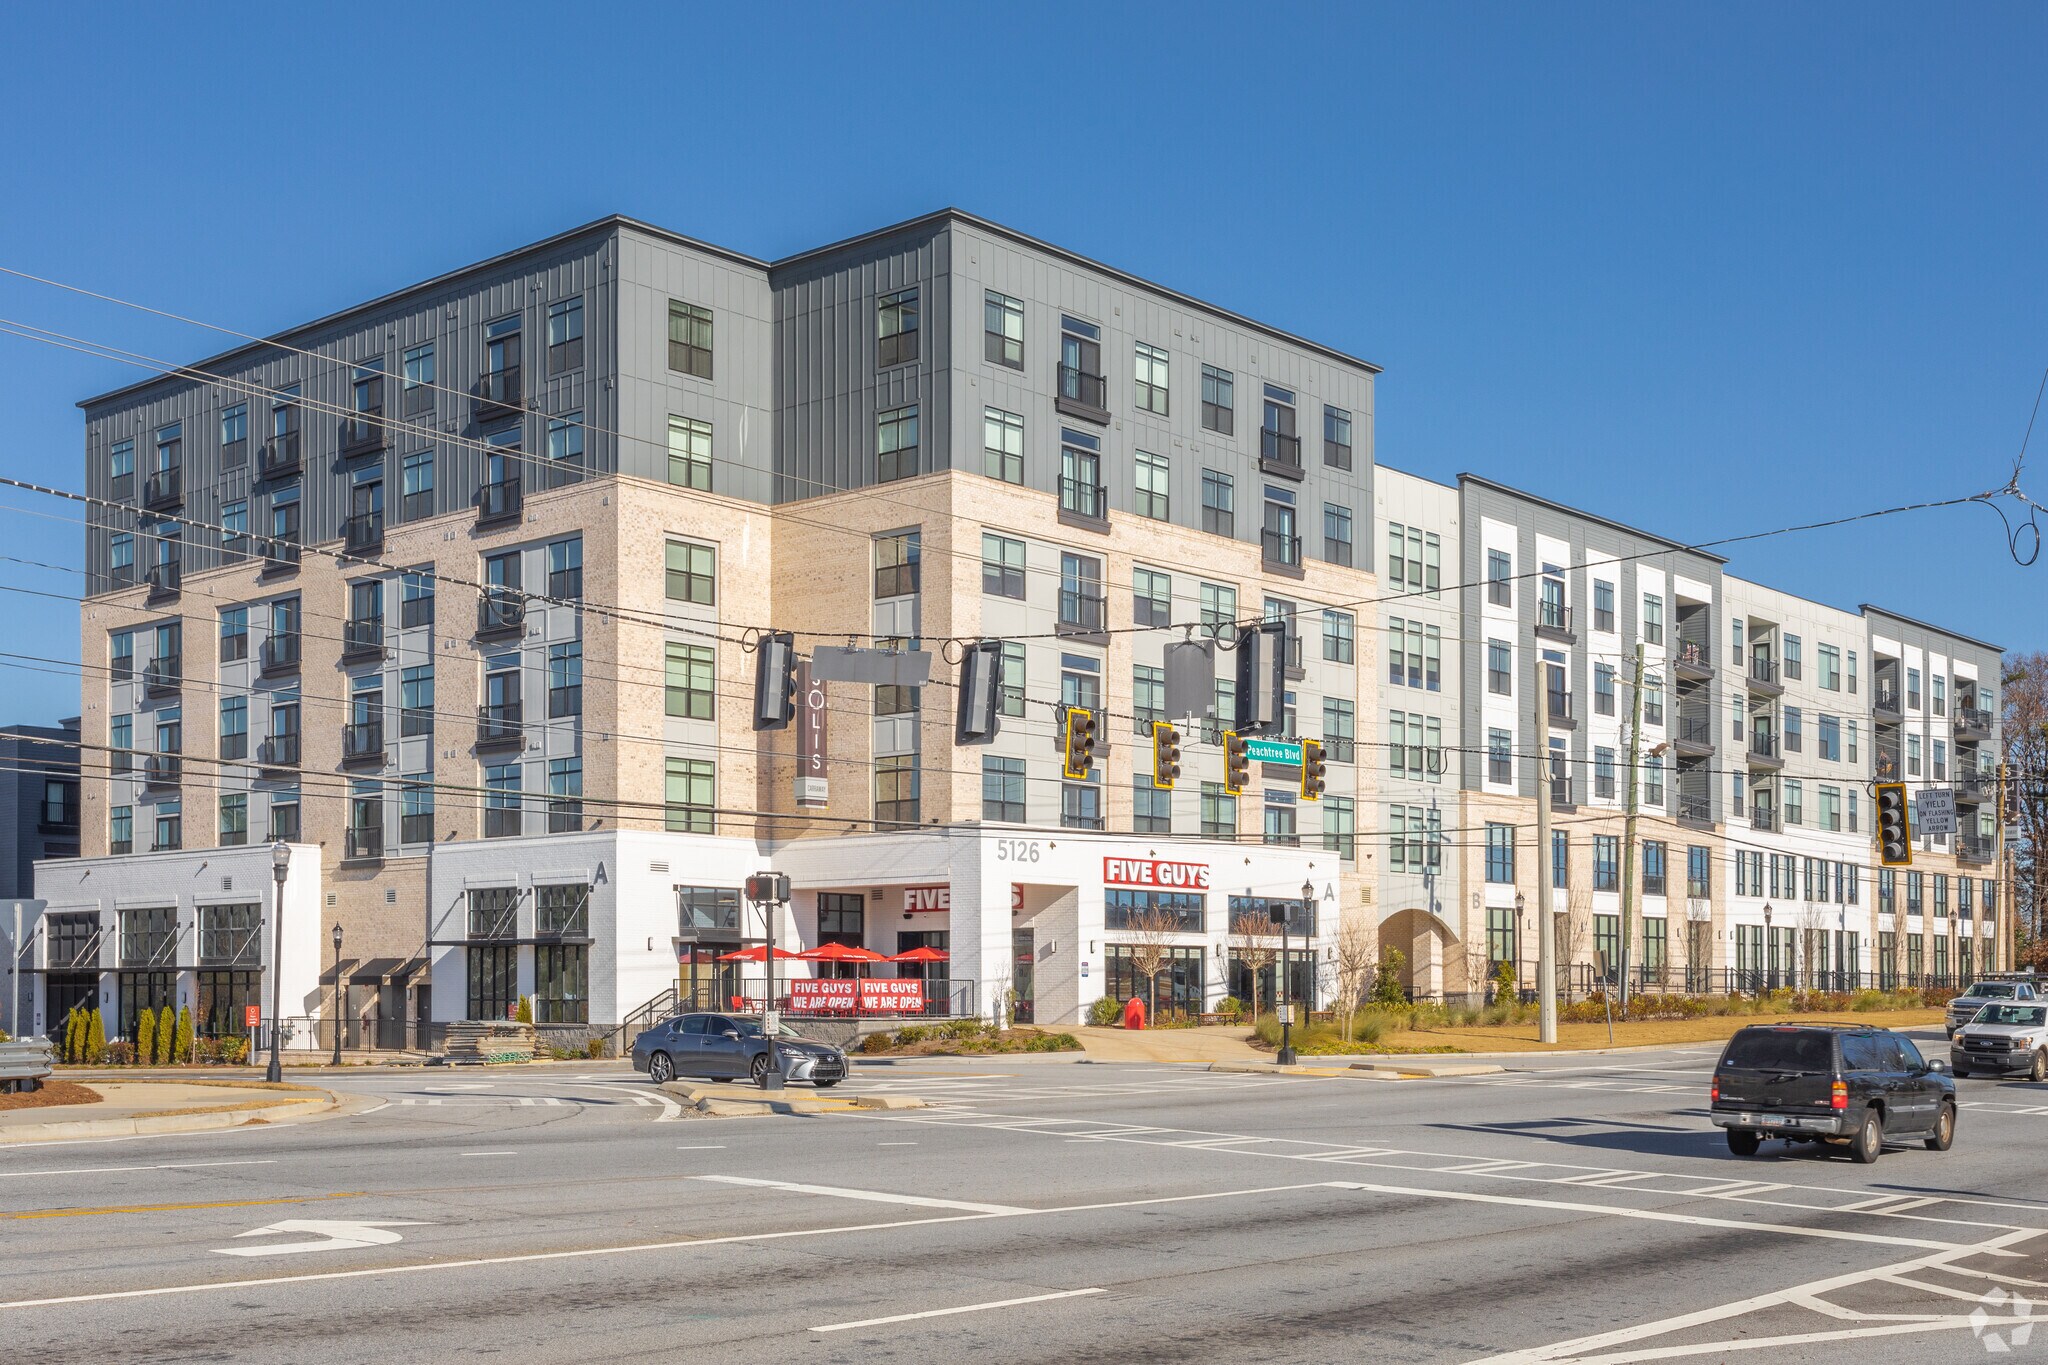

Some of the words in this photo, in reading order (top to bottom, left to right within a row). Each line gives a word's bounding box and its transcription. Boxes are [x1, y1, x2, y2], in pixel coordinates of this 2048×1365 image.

[1247, 745, 1283, 758] Peachtree
[1284, 749, 1301, 760] Blvd
[1925, 800, 1946, 808] YIELD
[1929, 809, 1954, 817] FLASHING
[997, 839, 1040, 863] 5126
[594, 861, 609, 885] A
[1107, 859, 1153, 883] FIVE
[1155, 862, 1210, 887] GUYS
[904, 888, 950, 910] FIVE
[1324, 882, 1335, 902] A
[1473, 892, 1481, 909] B
[795, 983, 819, 993] FIVE
[821, 983, 852, 993] GUYS
[864, 983, 889, 993] FIVE
[890, 983, 918, 993] GUYS
[793, 996, 807, 1008] WE
[809, 996, 826, 1008] ARE
[827, 996, 855, 1008] OPEN
[863, 996, 879, 1008] WE
[880, 996, 898, 1008] ARE
[899, 996, 921, 1008] OPEN
